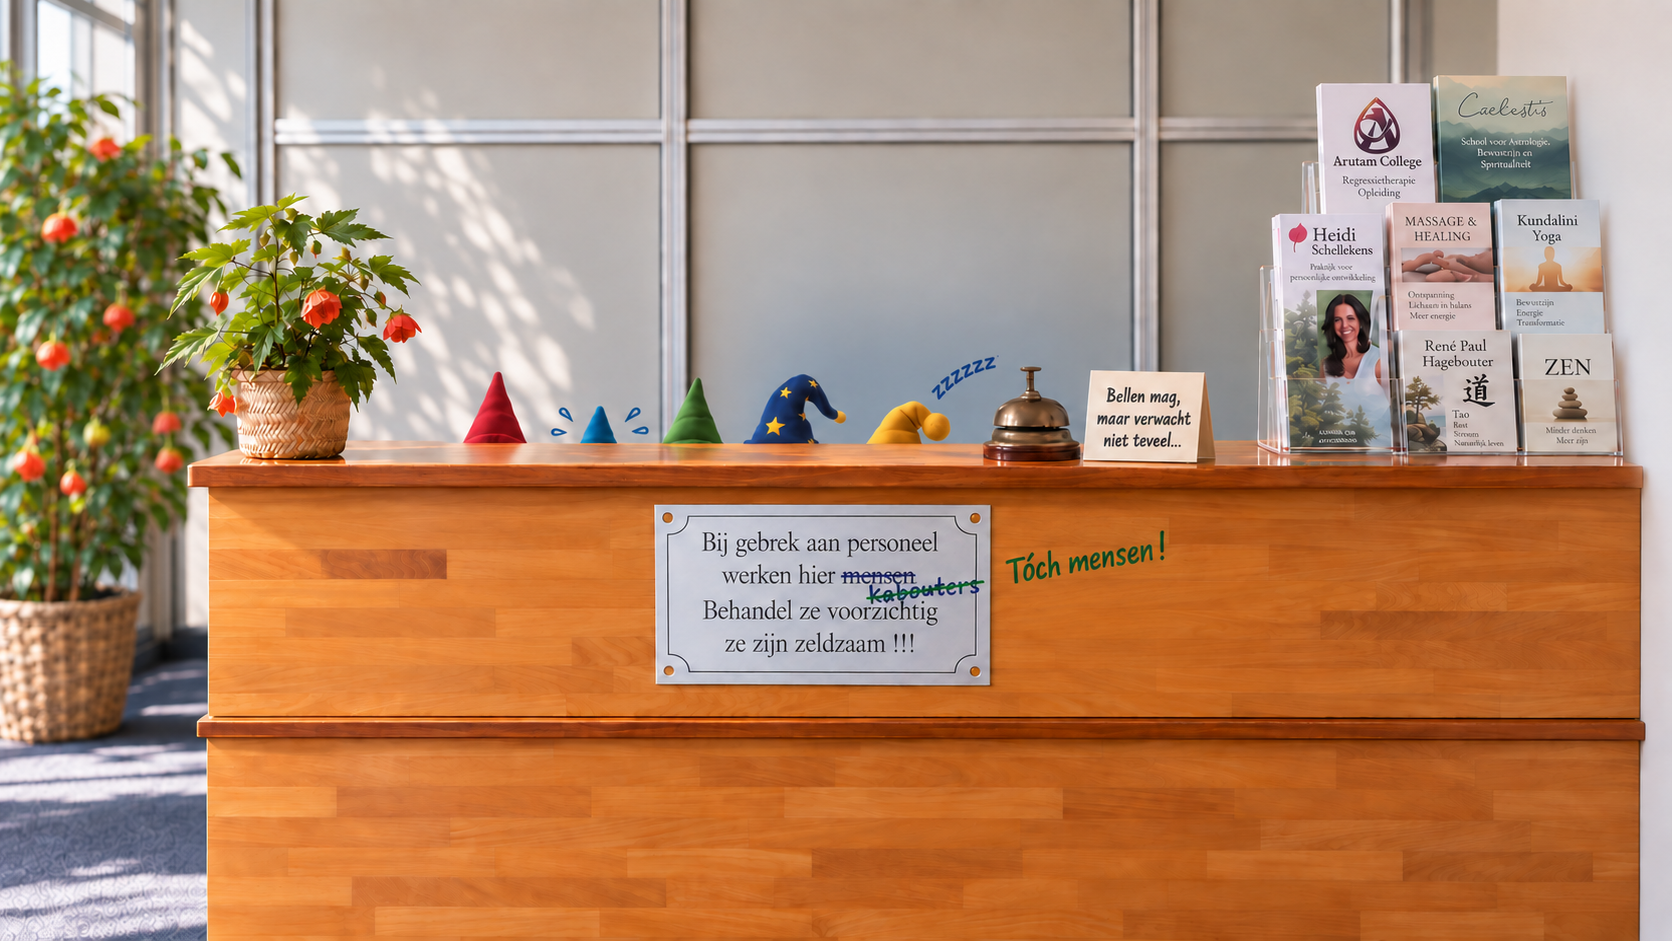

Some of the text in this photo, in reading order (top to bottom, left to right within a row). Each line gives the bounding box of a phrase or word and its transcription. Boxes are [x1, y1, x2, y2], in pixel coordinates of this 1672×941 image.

[1461, 137, 1487, 146] School
[1333, 155, 1422, 170] Arutam College
[1342, 175, 1416, 187] Regressietherapie
[1357, 187, 1401, 199] Opleiding
[1405, 216, 1477, 227] MASSAGE &
[1517, 214, 1578, 226] Kundalini
[1313, 227, 1356, 242] Heidi
[1414, 231, 1471, 241] HEALING
[1532, 230, 1562, 245] Yoga
[1311, 244, 1373, 255] Schellekens
[1430, 312, 1456, 321] energie
[1425, 339, 1487, 352] René Paul
[1422, 355, 1494, 371] Hagebouter
[1544, 358, 1591, 376] ZEN
[1106, 386, 1181, 409] Bellen mag,
[1462, 373, 1496, 408] 道
[1096, 409, 1191, 425] maar verwacht
[1452, 409, 1470, 419] Tao
[1545, 426, 1597, 434] Minder denken
[1103, 431, 1182, 448] niet teveel...
[701, 531, 939, 558] Bij gebrek aan personeel
[1005, 549, 1061, 584] Tóch
[721, 564, 917, 585] werken hier mensen
[867, 577, 982, 604] kabouters
[702, 599, 939, 626] Behandel ze voorzichtig
[725, 632, 915, 658] ze zijn zeldzaam !!!
